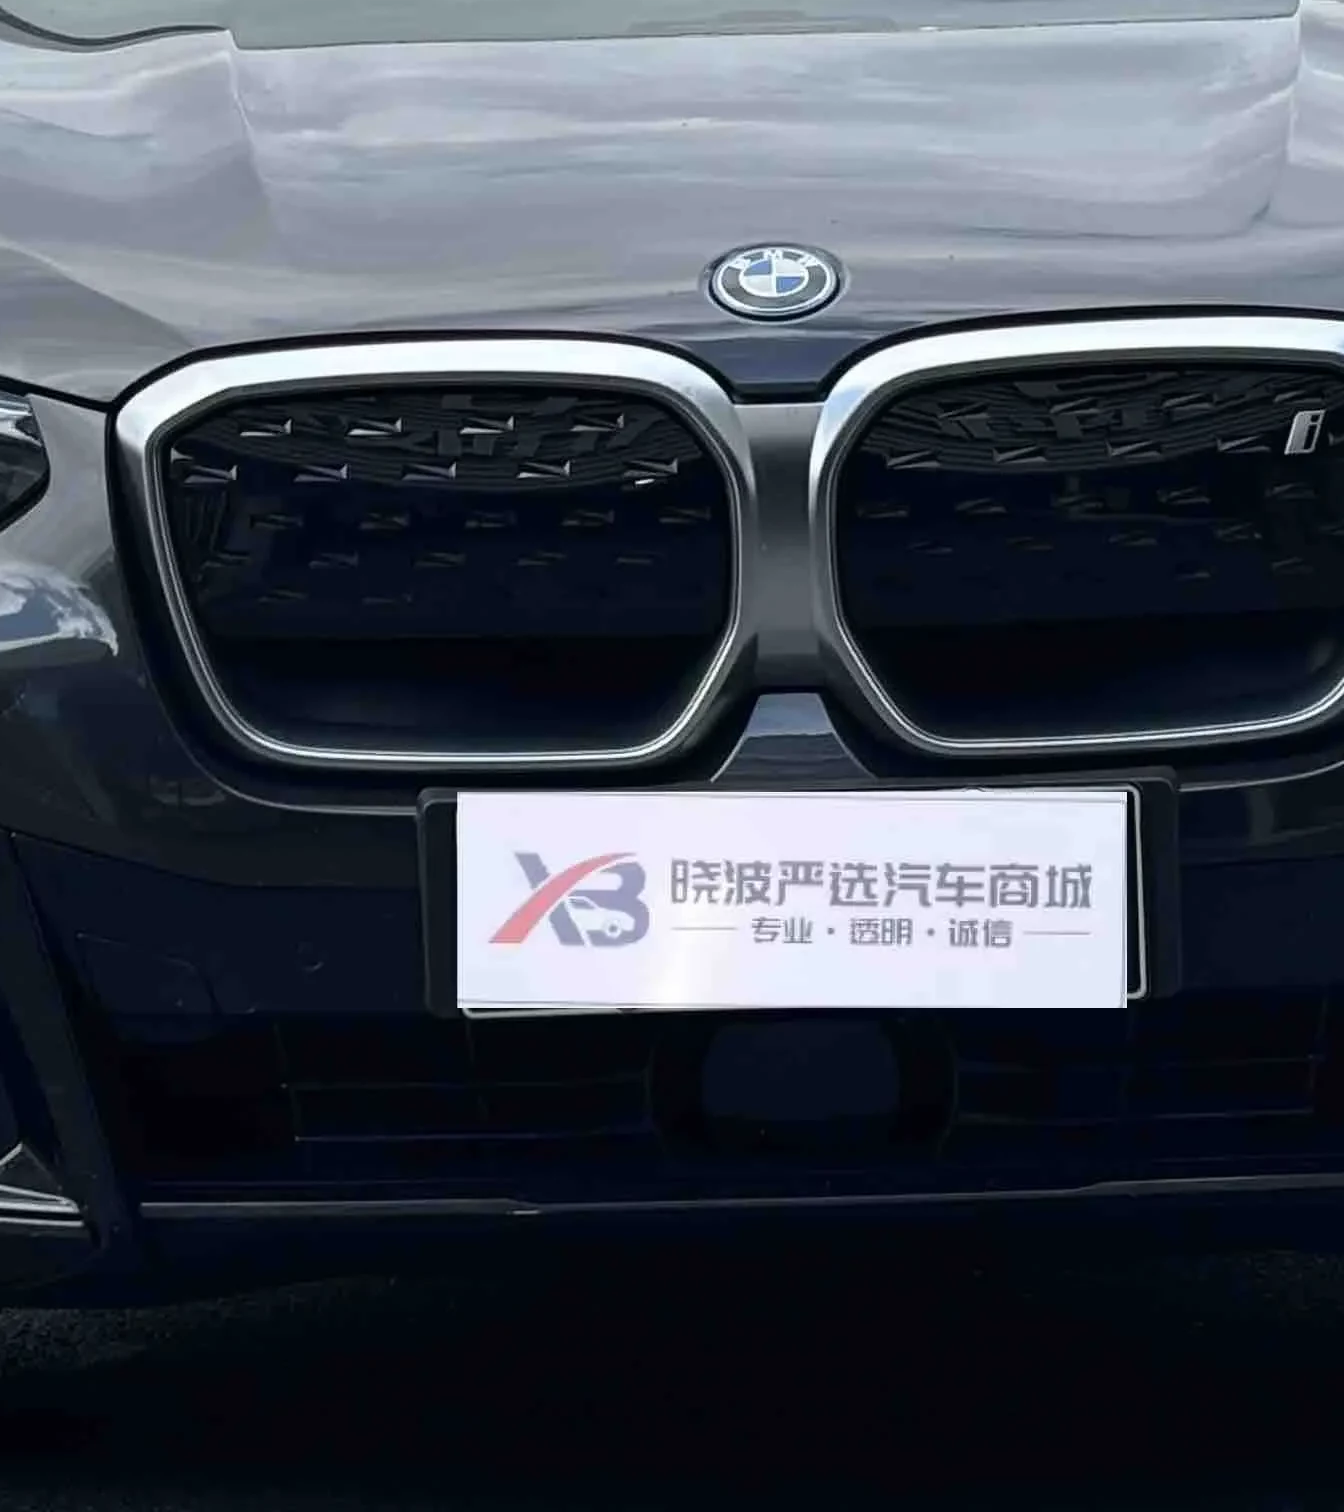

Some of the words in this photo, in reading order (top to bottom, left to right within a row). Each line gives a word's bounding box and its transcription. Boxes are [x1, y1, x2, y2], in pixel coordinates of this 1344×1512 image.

[670, 858, 1092, 908] 晓波严选汽车商城
